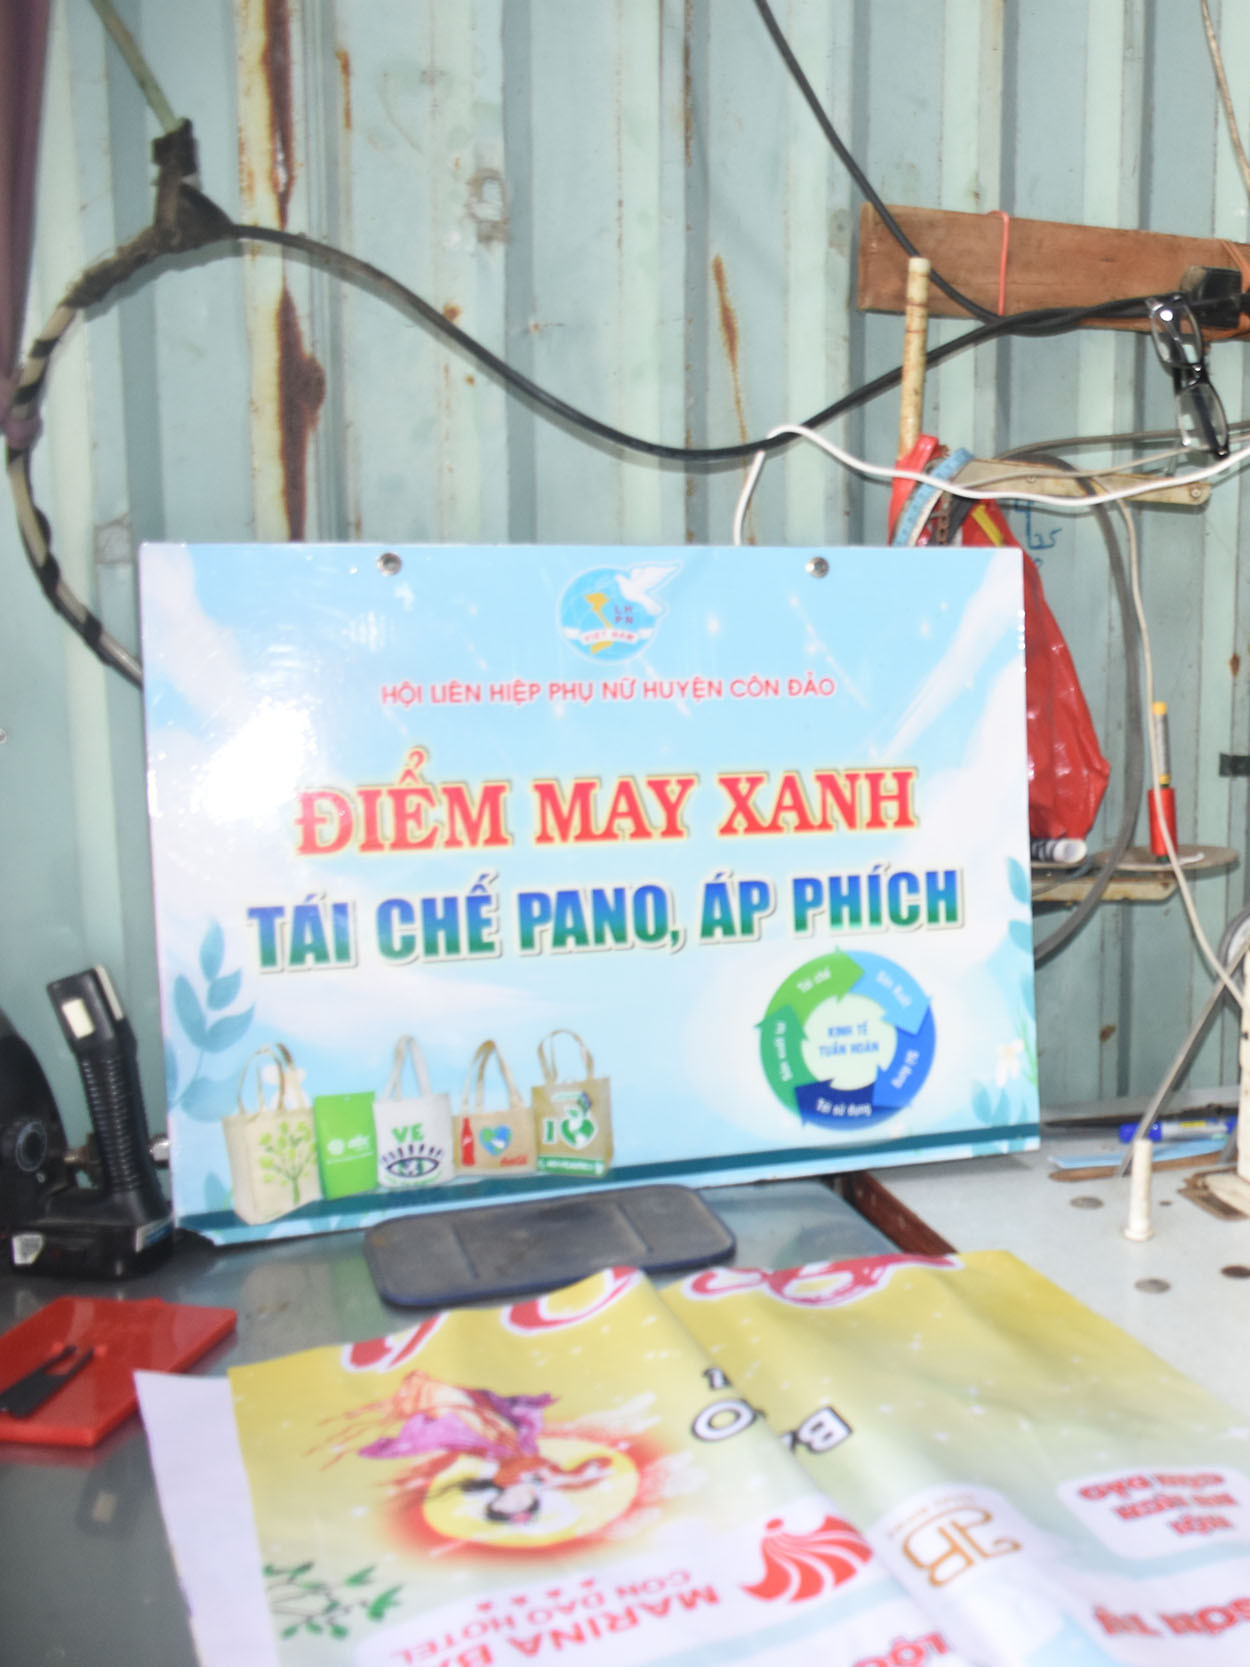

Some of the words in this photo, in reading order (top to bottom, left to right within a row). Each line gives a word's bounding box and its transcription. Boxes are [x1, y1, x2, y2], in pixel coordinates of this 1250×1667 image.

[381, 680, 423, 709] HỘI
[431, 679, 482, 704] LIÊN
[489, 679, 541, 706] HIỆP
[549, 681, 594, 704] PHỤ
[602, 677, 637, 700] NỮ
[642, 675, 723, 702] HUYỆN
[729, 674, 780, 698] CÔN
[787, 670, 835, 697] ĐẢO
[294, 746, 512, 857] ĐIỂM
[531, 777, 698, 846] MAY
[716, 770, 918, 838] XANH
[247, 893, 352, 968] TÁI
[375, 872, 498, 962] CHẾ
[516, 884, 681, 951] PANO,
[699, 871, 772, 940] ÁP
[791, 864, 959, 933] PHÍCH
[507, 1584, 719, 1657] MARINA
